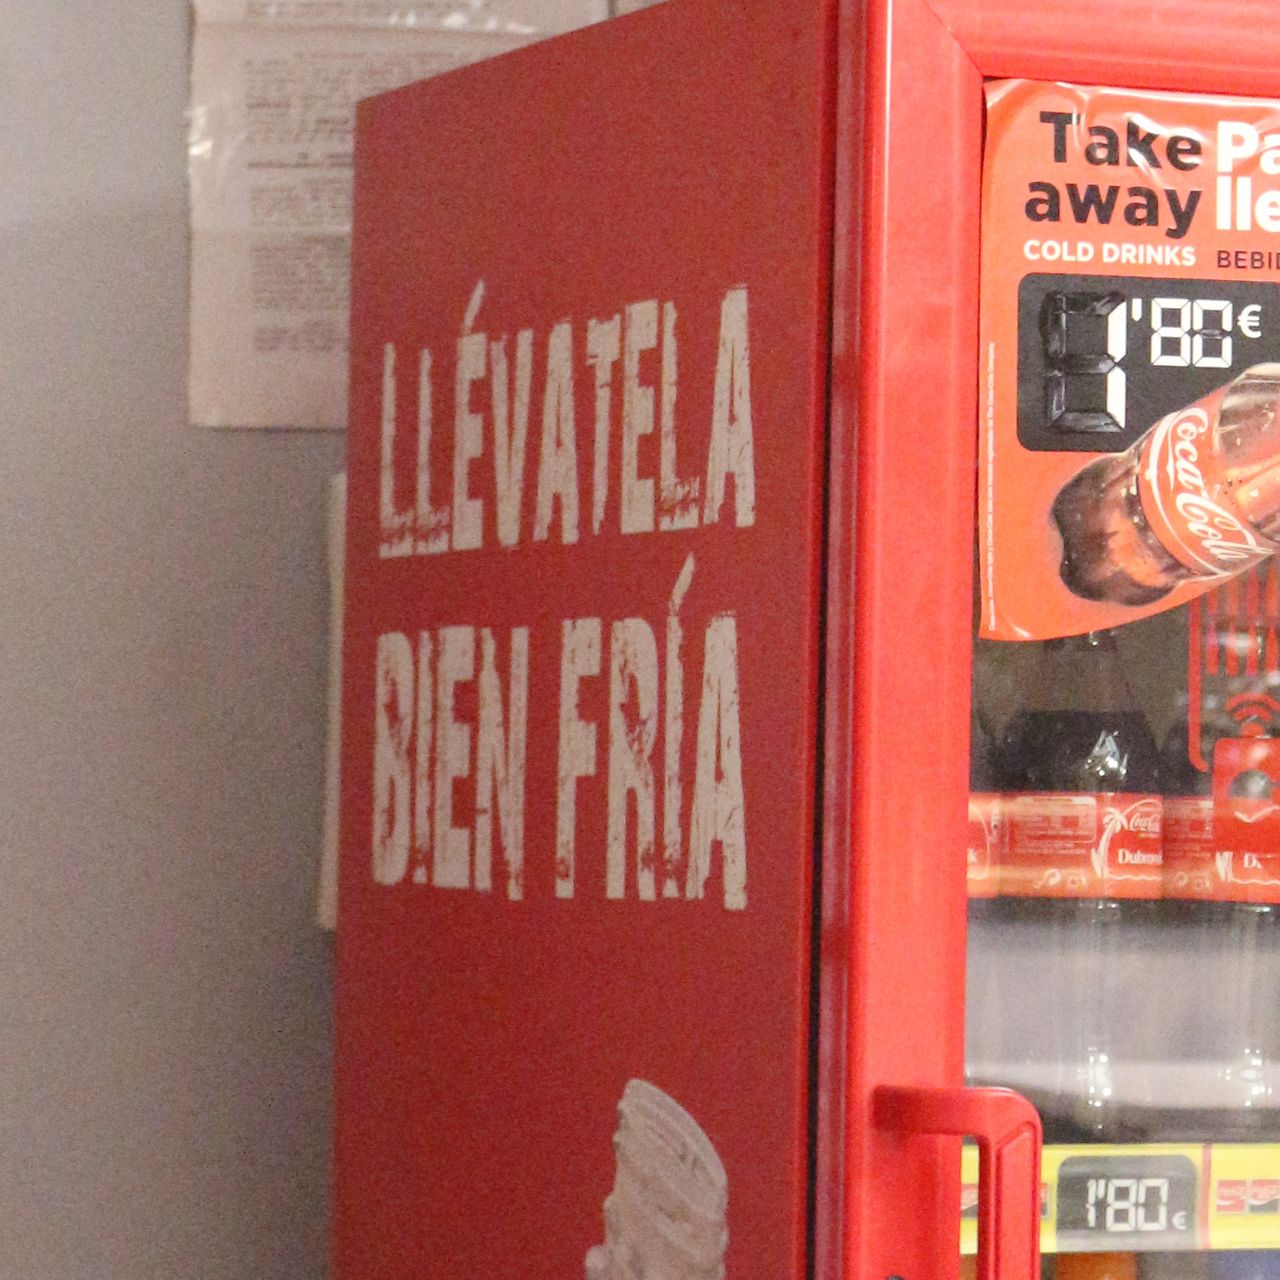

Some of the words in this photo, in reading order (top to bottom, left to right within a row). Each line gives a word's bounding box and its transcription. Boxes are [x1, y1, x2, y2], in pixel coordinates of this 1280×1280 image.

[1039, 110, 1203, 172] Take
[1024, 180, 1203, 240] away
[1023, 239, 1095, 263] COLD
[1101, 243, 1197, 267] DRINKS
[372, 625, 530, 902] BIEN
[554, 553, 749, 912] FRÍA
